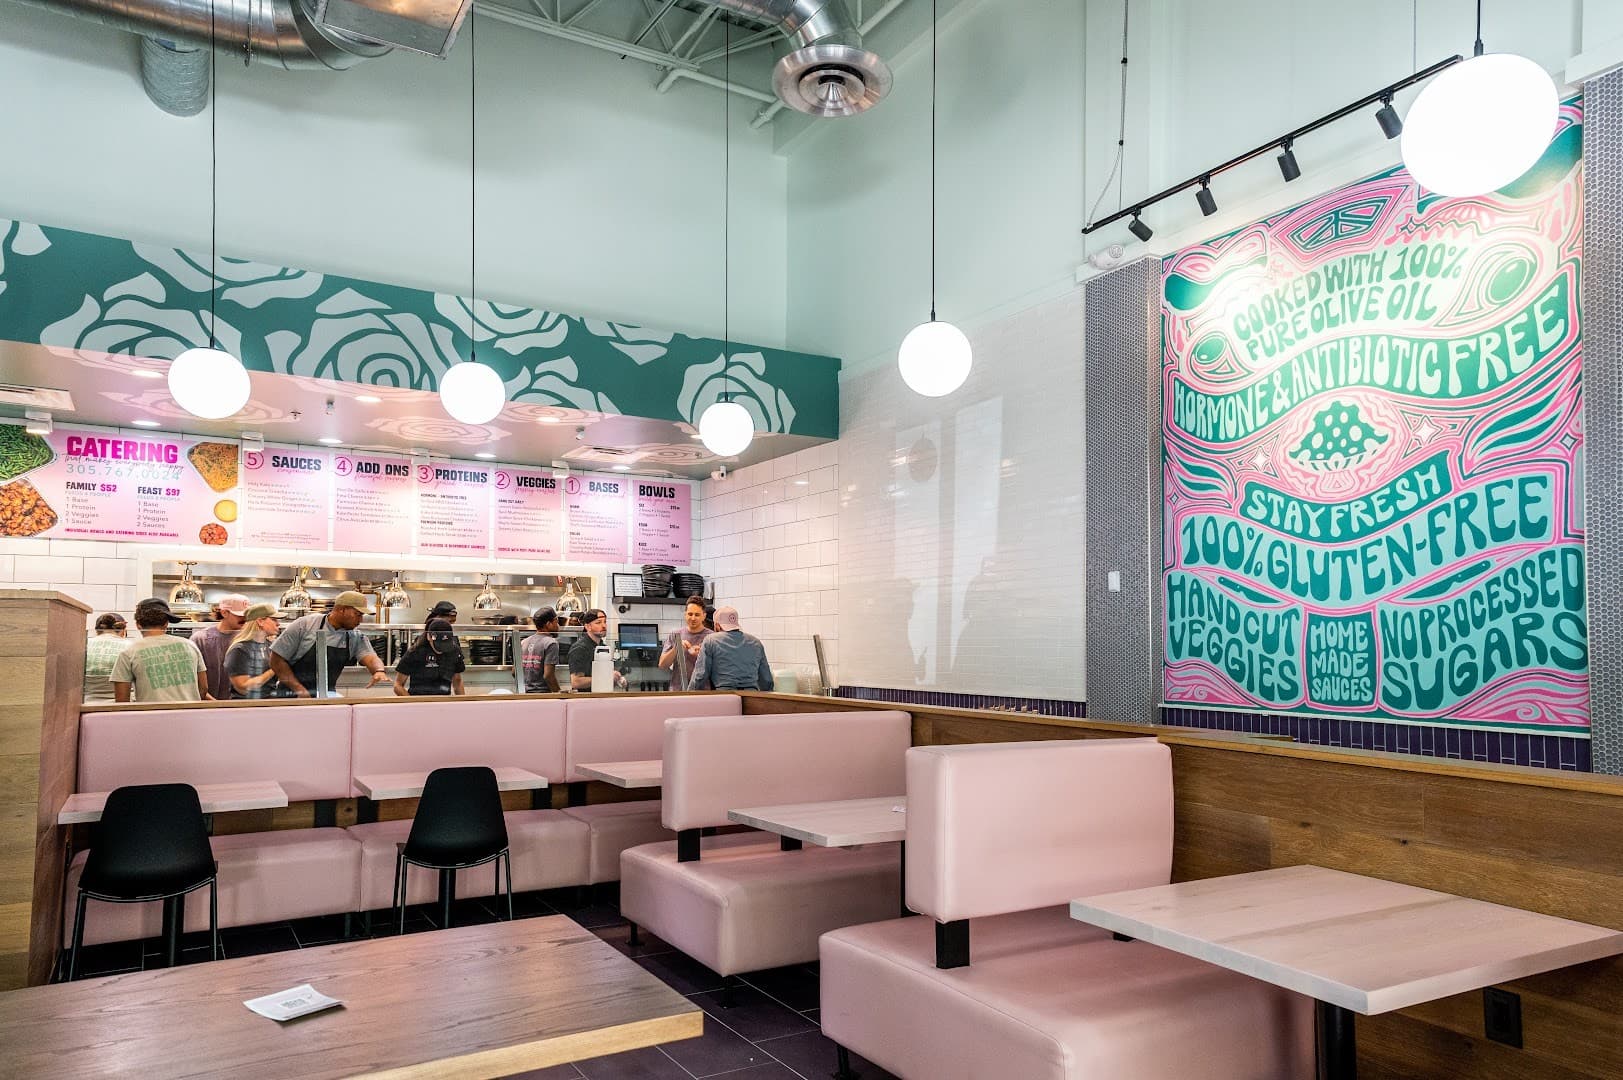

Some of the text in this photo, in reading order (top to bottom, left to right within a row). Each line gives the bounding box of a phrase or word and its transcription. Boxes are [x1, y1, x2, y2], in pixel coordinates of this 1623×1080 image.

[1233, 243, 1465, 341] COOKED WITH 100%
[1246, 281, 1439, 363] PURE OLIVE OIL
[1174, 285, 1567, 441] HORMONE & ANTIBIOTIC FREE
[67, 436, 178, 464] CATERING
[272, 455, 322, 471] SAUCES
[356, 462, 409, 477] ADD ONS
[435, 468, 488, 483] PROTEINS
[516, 476, 556, 489] VEGGIES
[65, 481, 117, 493] FAMILY $52
[137, 486, 162, 495] FEAST
[589, 481, 619, 494] BASES
[639, 485, 675, 499] BOWLS
[1246, 466, 1441, 538] STAY FRESH
[1182, 476, 1548, 601] 100% GLUTEN-FREE
[1167, 575, 1300, 657] HAND CUT
[1380, 548, 1584, 660] NO PROCESSED
[1311, 619, 1368, 652] HOME
[1169, 620, 1299, 702] VEGGIES
[1312, 650, 1369, 678] MADE
[1381, 612, 1588, 710] SUGARS
[1311, 676, 1373, 702] SAUCES
